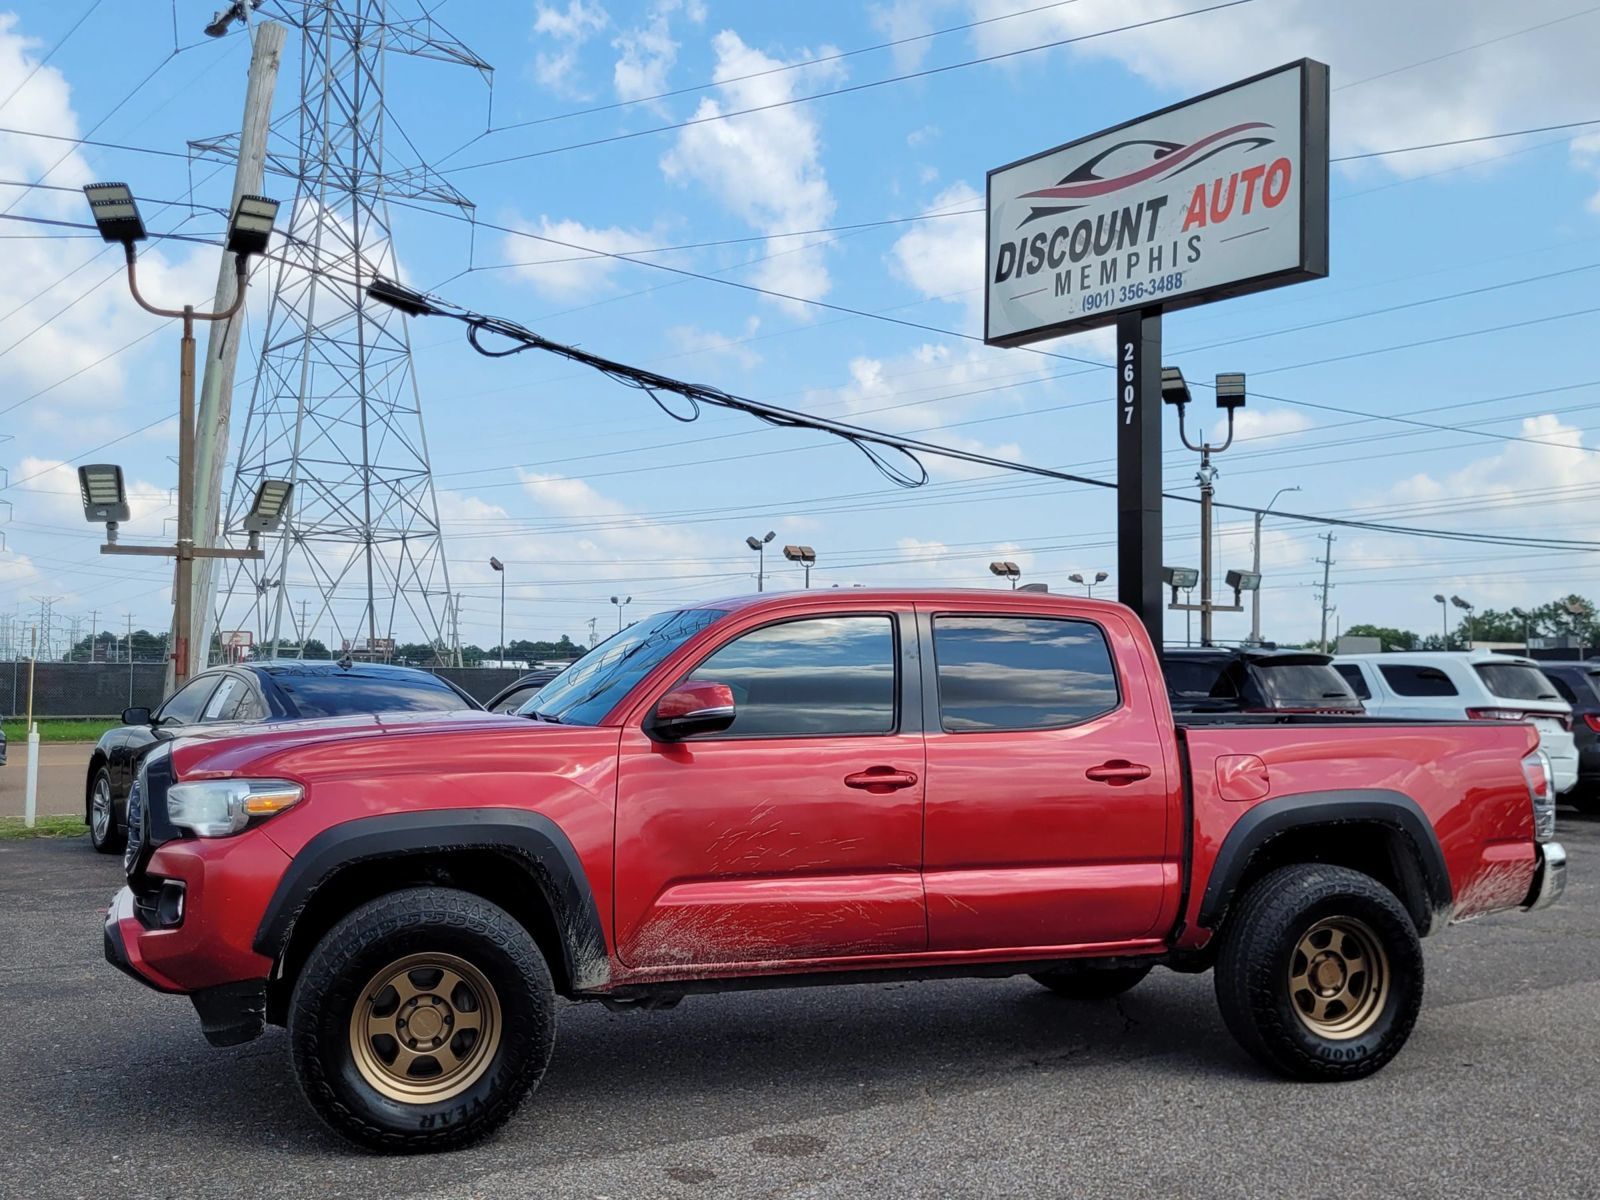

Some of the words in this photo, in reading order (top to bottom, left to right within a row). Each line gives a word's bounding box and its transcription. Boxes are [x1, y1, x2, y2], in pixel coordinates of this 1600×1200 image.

[994, 195, 1168, 283] DISCOUNT
[1182, 157, 1292, 233] AUTO
[1054, 235, 1201, 297] MEMPHIS
[1082, 291, 1115, 312] (901)
[1119, 272, 1183, 303] 356-3488
[1124, 342, 1134, 425] 2607
